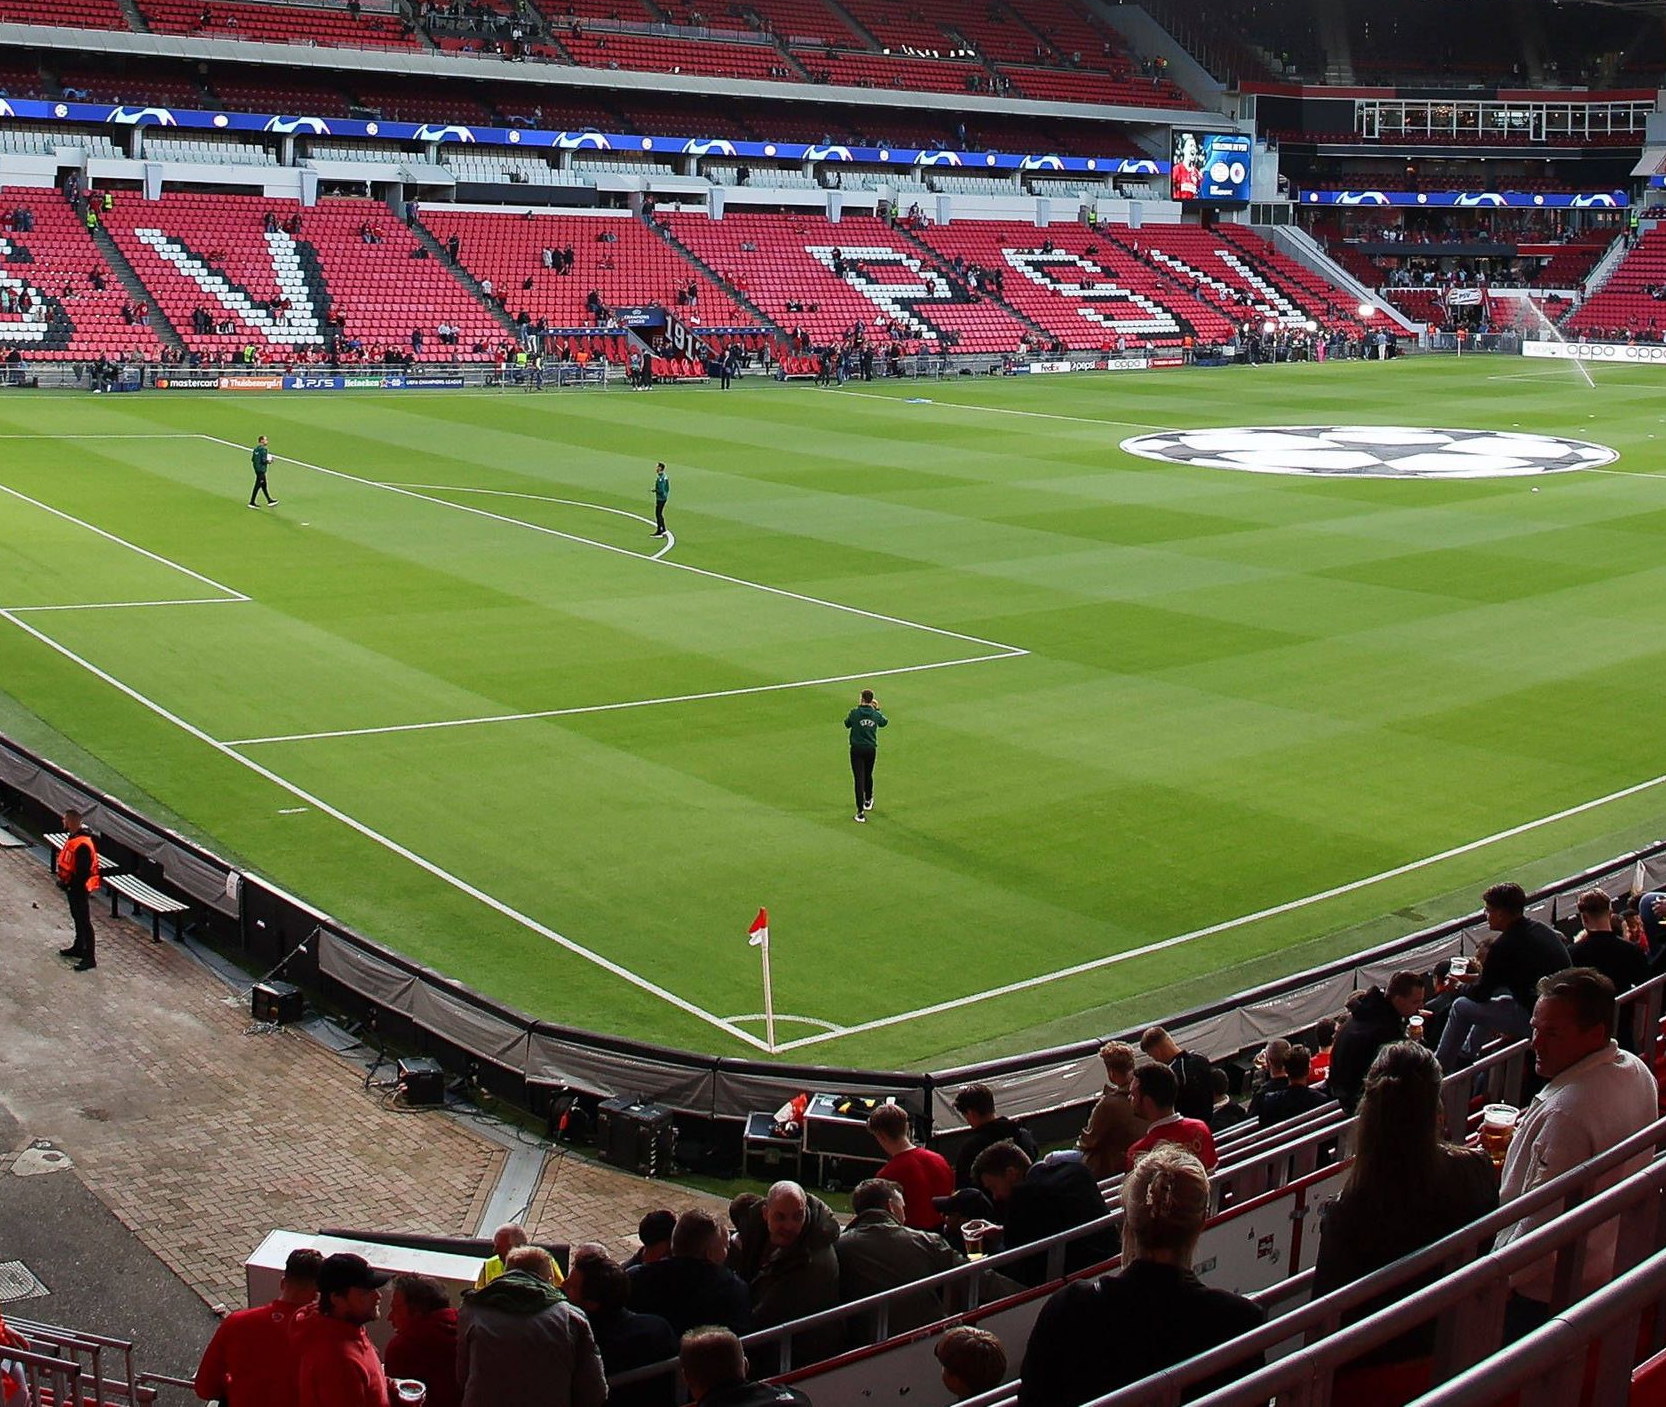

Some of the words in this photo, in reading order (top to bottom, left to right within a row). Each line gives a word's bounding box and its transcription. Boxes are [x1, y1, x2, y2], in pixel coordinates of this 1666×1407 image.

[1567, 344, 1615, 360] oppo
[170, 378, 219, 387] mastercard
[306, 379, 334, 387] PS5
[344, 378, 379, 388] Heineken
